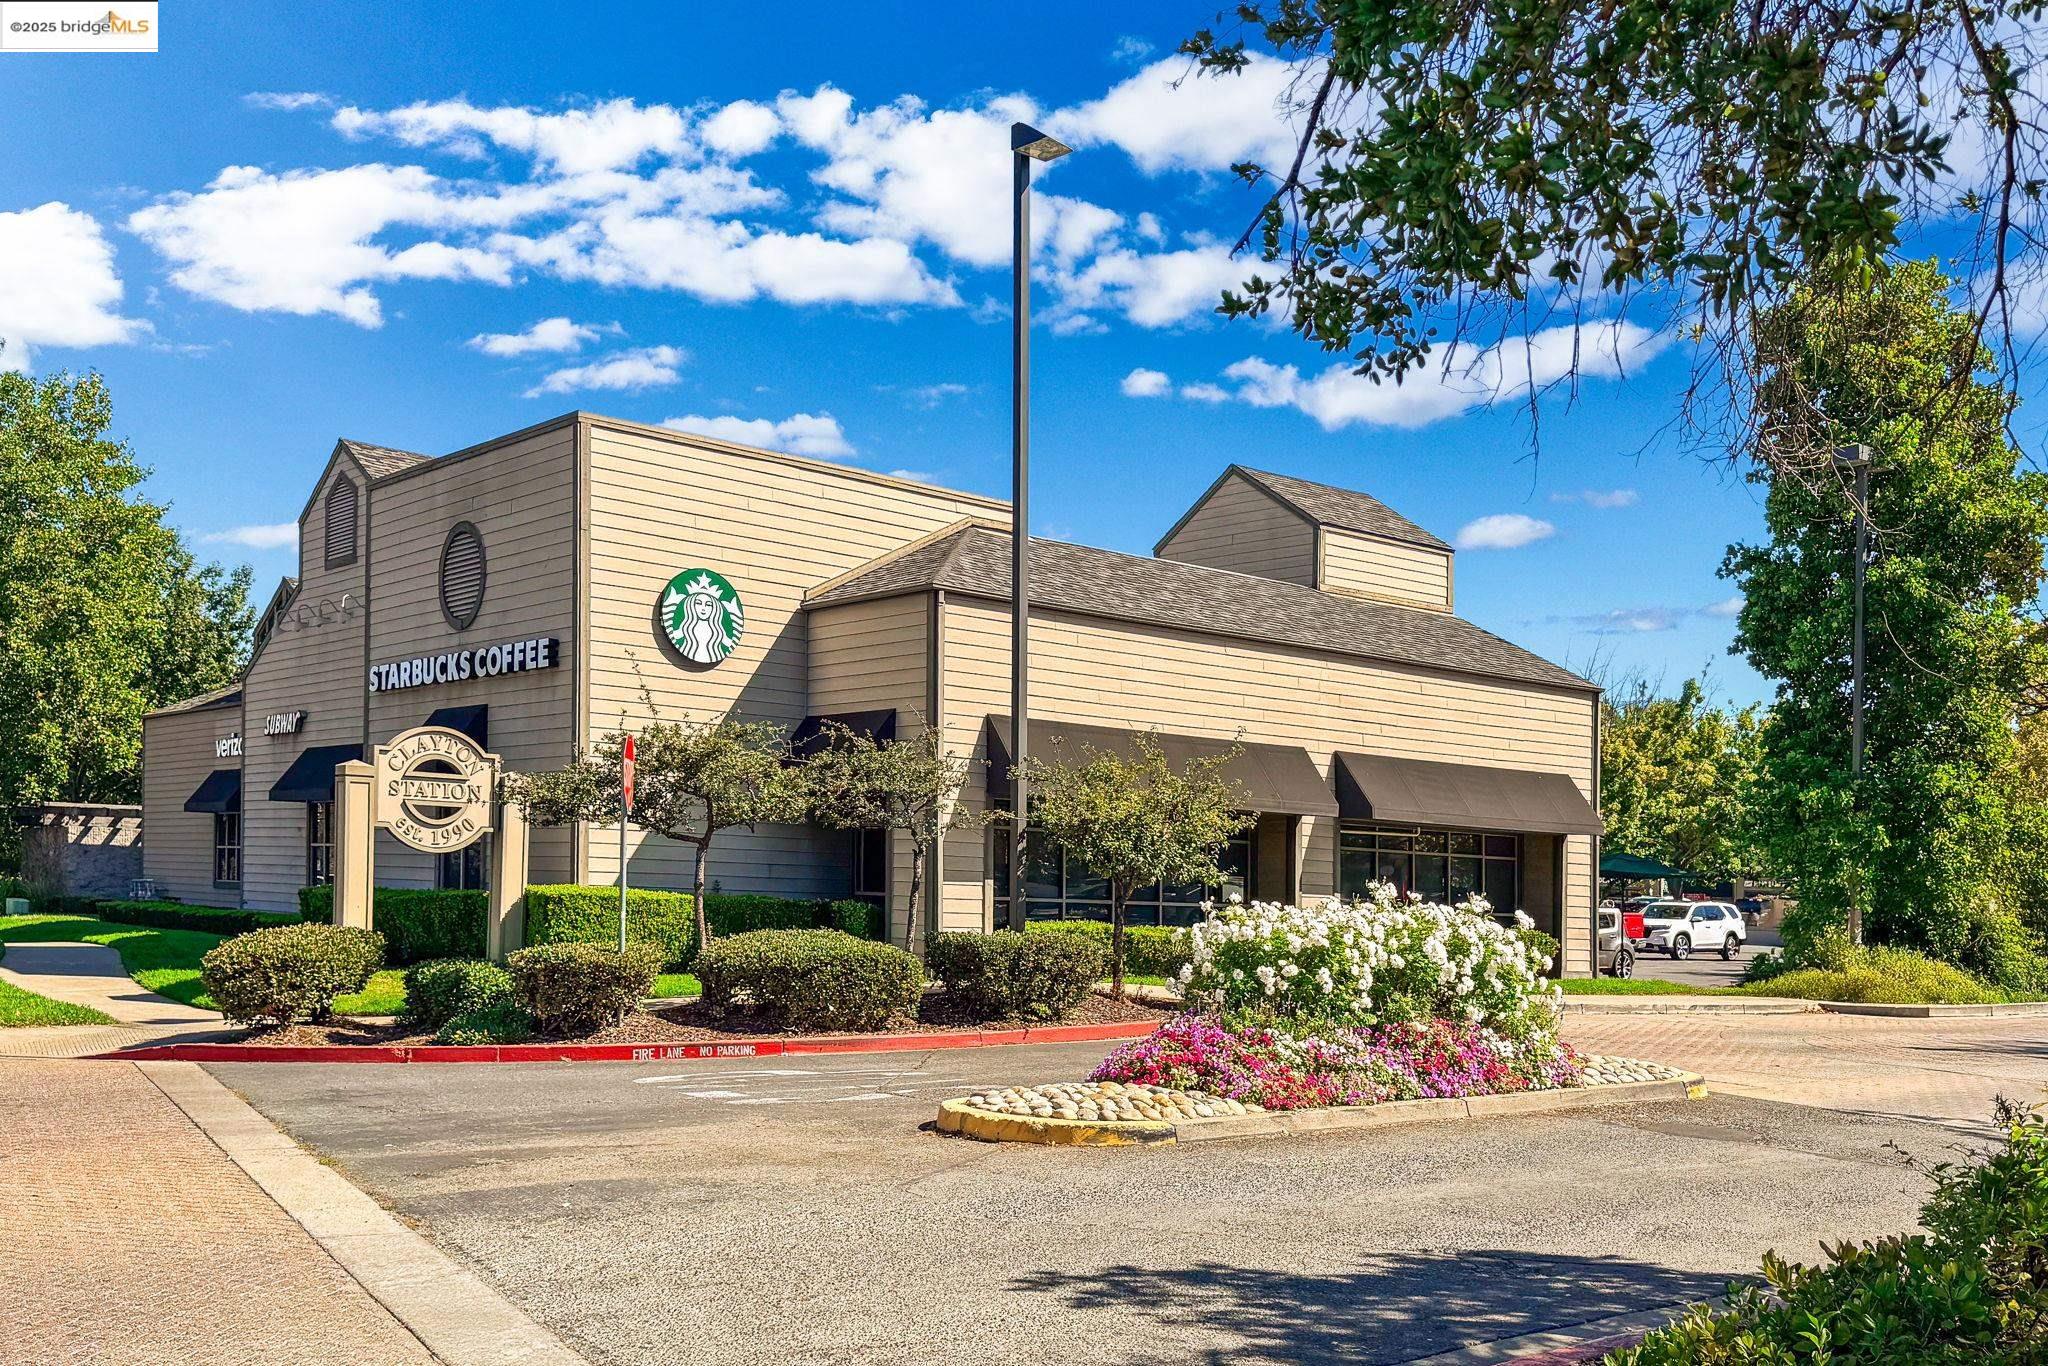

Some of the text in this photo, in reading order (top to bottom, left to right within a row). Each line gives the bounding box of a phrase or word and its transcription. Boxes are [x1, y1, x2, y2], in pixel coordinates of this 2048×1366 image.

[369, 637, 550, 692] STARBUCKS COFFEE
[264, 711, 300, 735] SUBWAY
[388, 735, 484, 776] CLAYTON
[388, 780, 482, 801] STATION
[430, 818, 475, 846] 1990
[632, 1049, 656, 1061] FIRE
[660, 1047, 685, 1059] LANE
[699, 1046, 713, 1056] NO
[717, 1045, 756, 1057] PARKING
